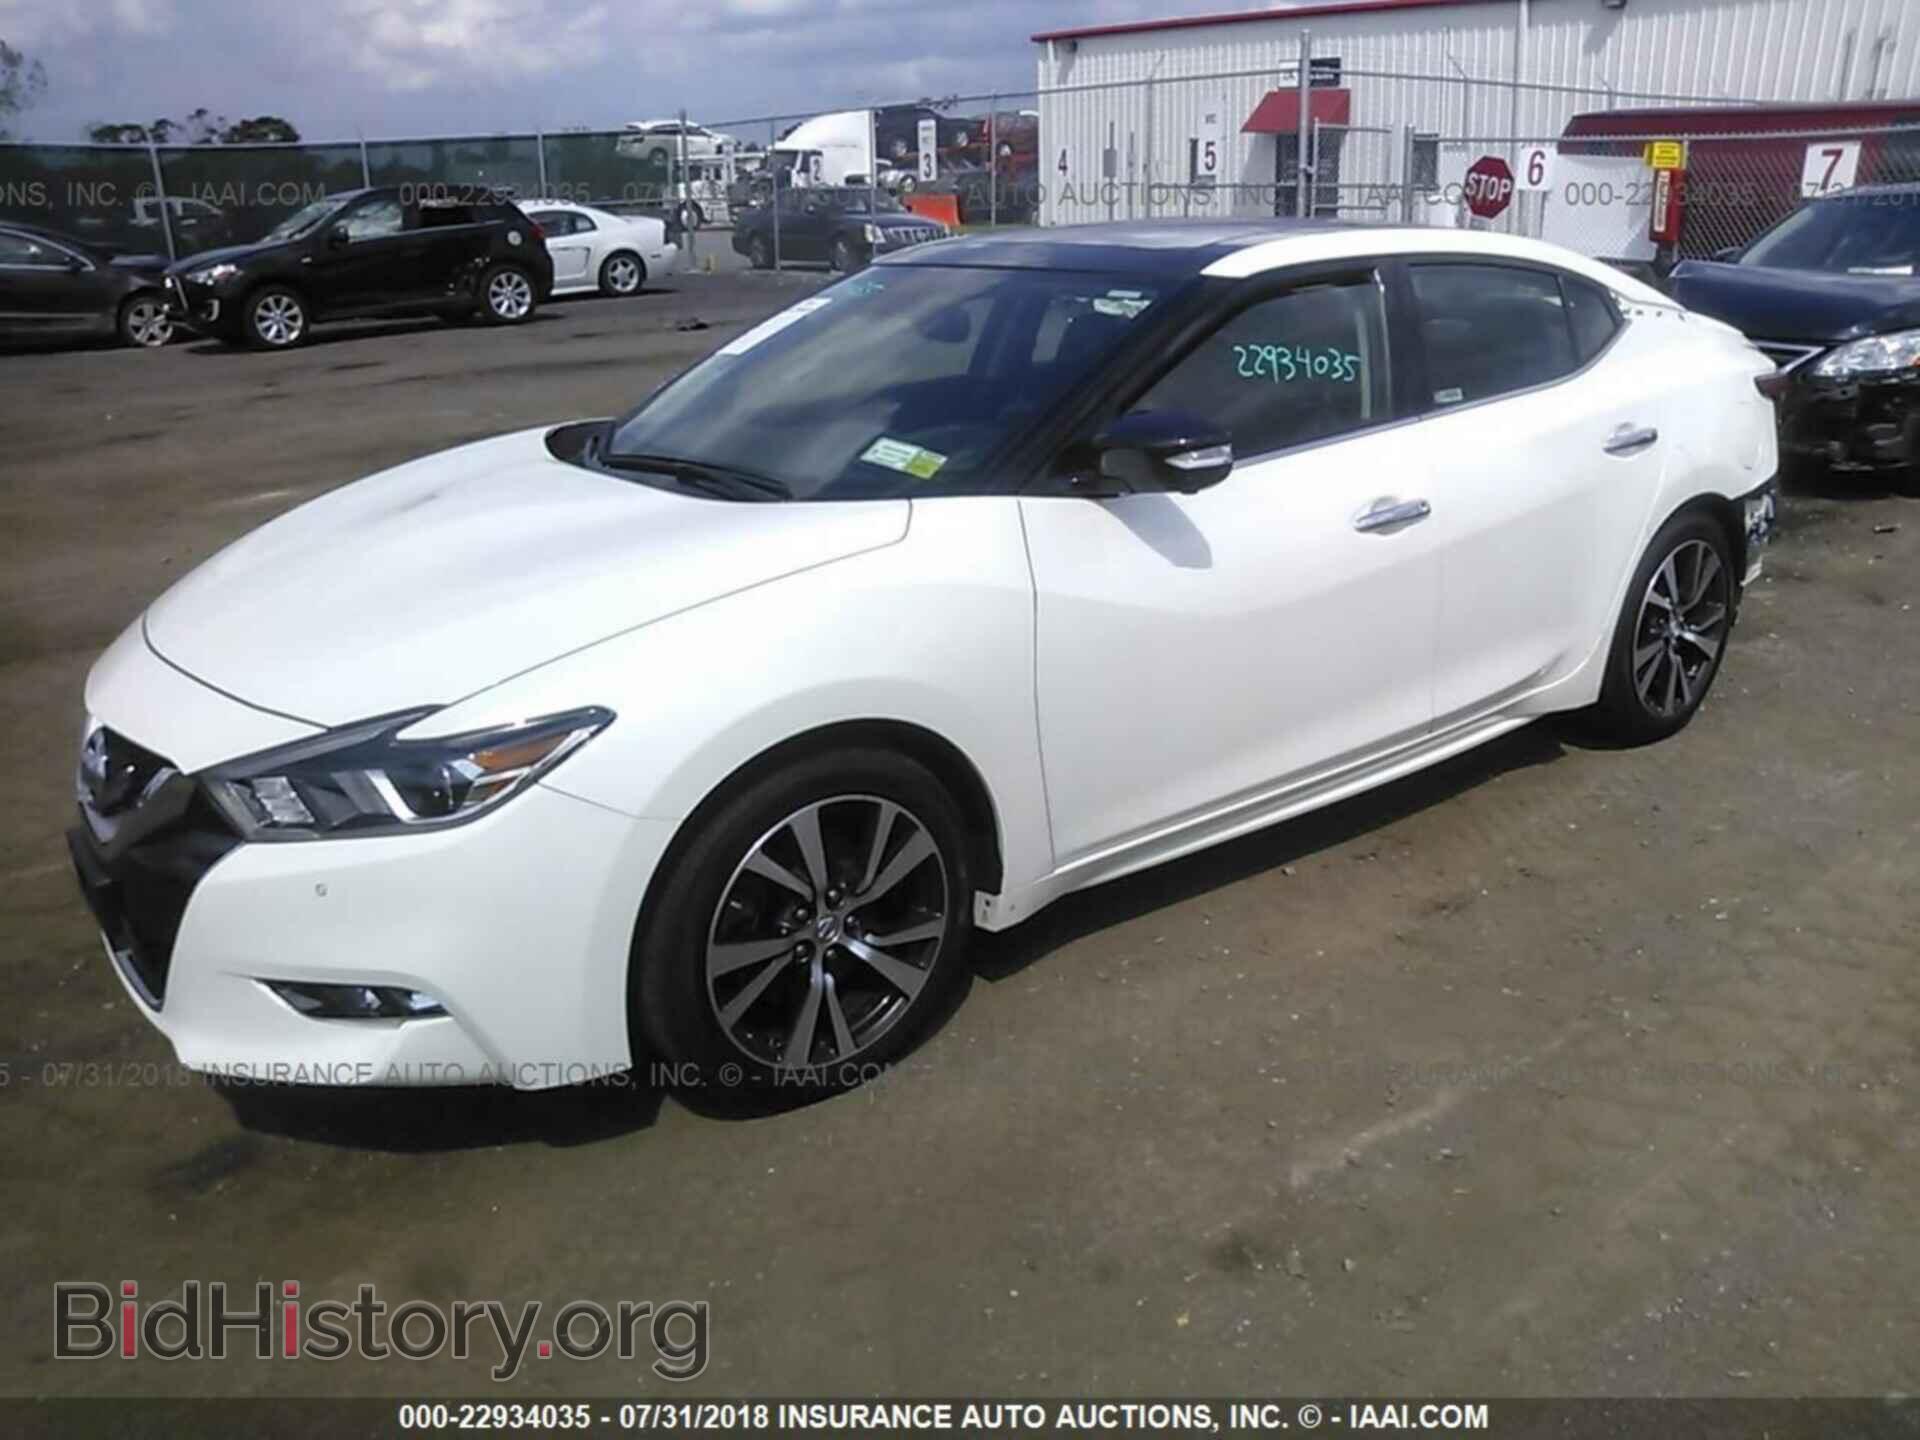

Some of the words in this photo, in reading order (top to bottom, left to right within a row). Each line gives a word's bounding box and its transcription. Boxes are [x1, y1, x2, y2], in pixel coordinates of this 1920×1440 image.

[923, 153, 932, 178] 3
[1058, 149, 1068, 176] 4
[1204, 140, 1216, 171] 5
[1527, 150, 1546, 187] 6
[1822, 148, 1844, 191] 7
[1465, 172, 1511, 203] STOP
[1233, 345, 1361, 384] 22934035
